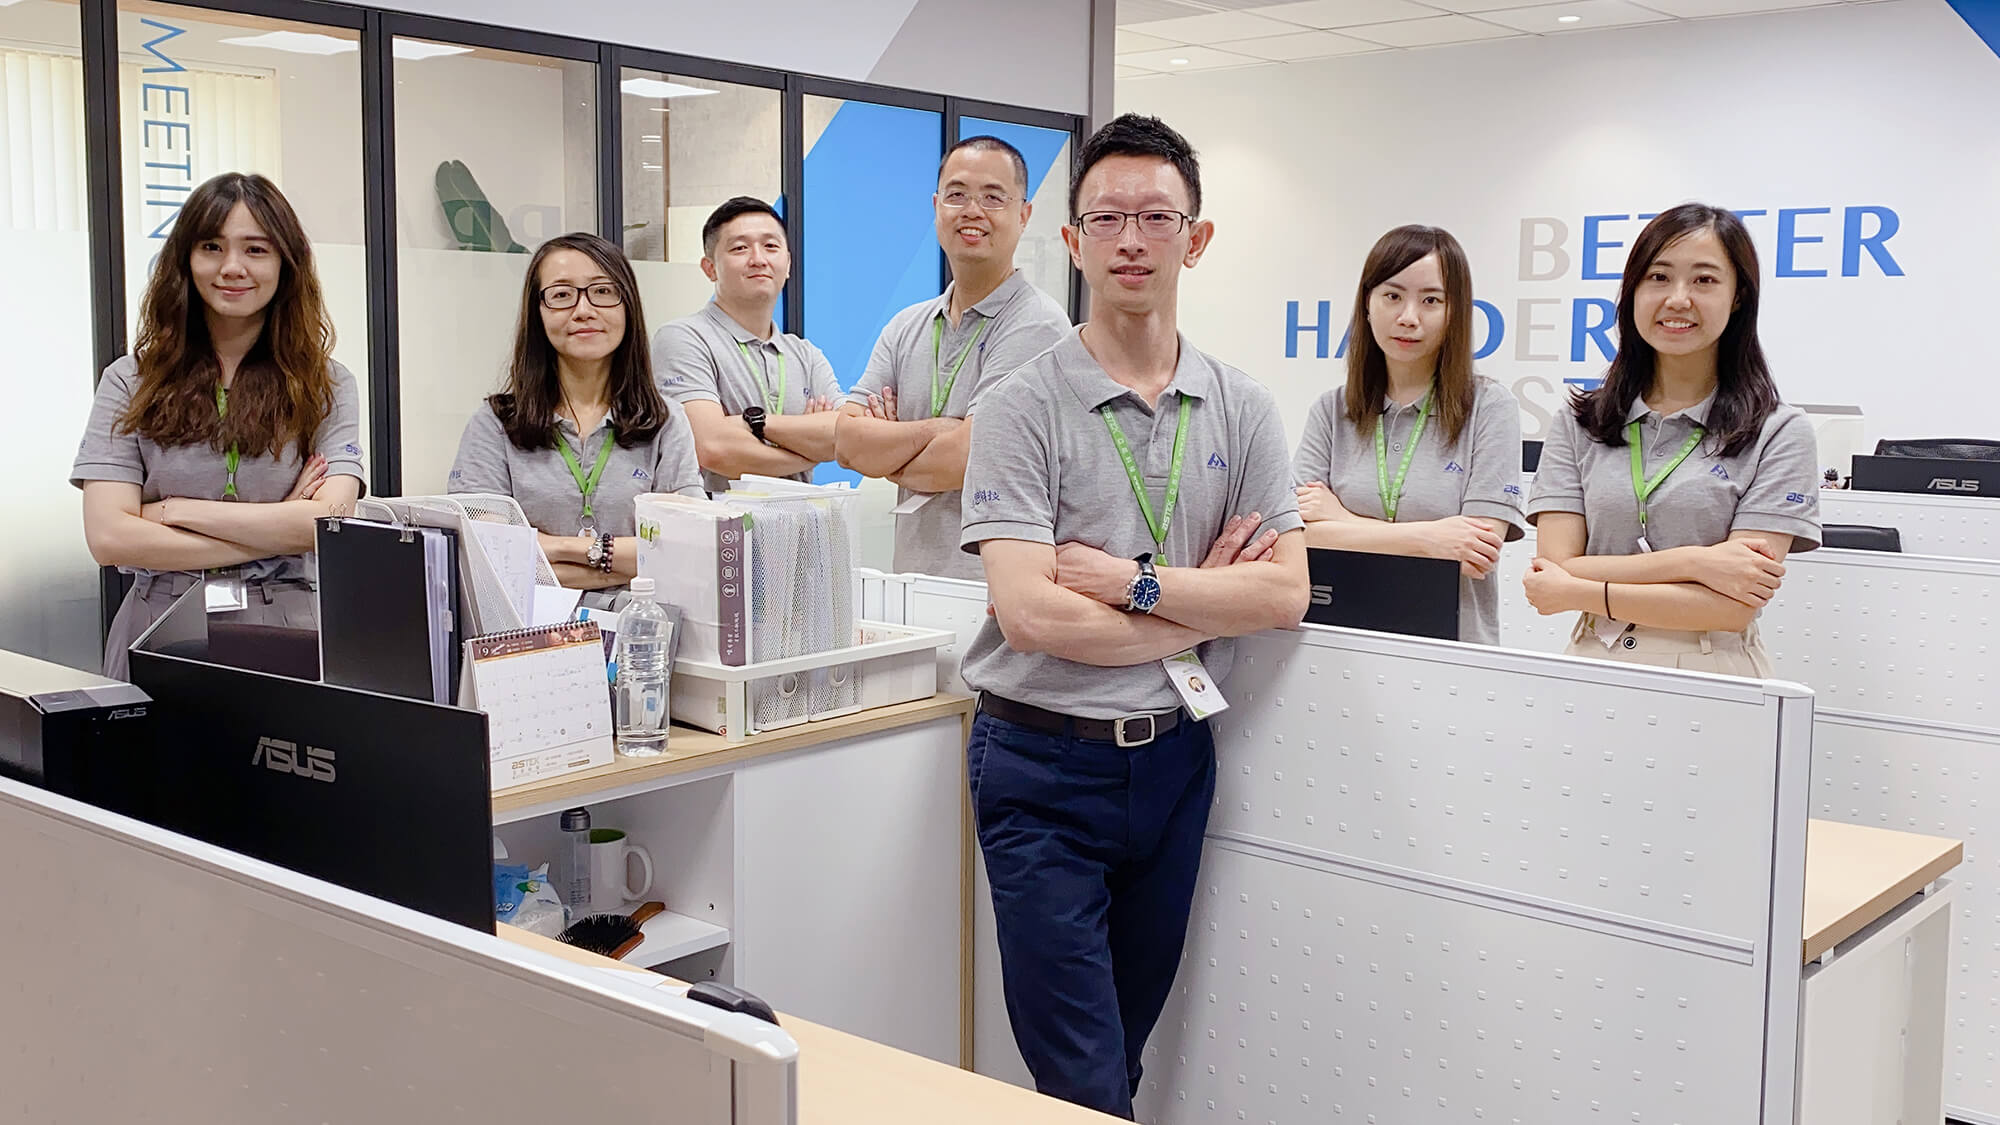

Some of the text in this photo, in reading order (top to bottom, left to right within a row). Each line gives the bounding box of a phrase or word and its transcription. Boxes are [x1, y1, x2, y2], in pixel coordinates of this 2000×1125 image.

[140, 18, 191, 281] MEETIN
[1518, 205, 1906, 281] BEER
[1285, 298, 1619, 362] HDER
[1927, 478, 1980, 492] ASUS
[107, 707, 148, 721] ASUS
[251, 736, 337, 784] ASUS
